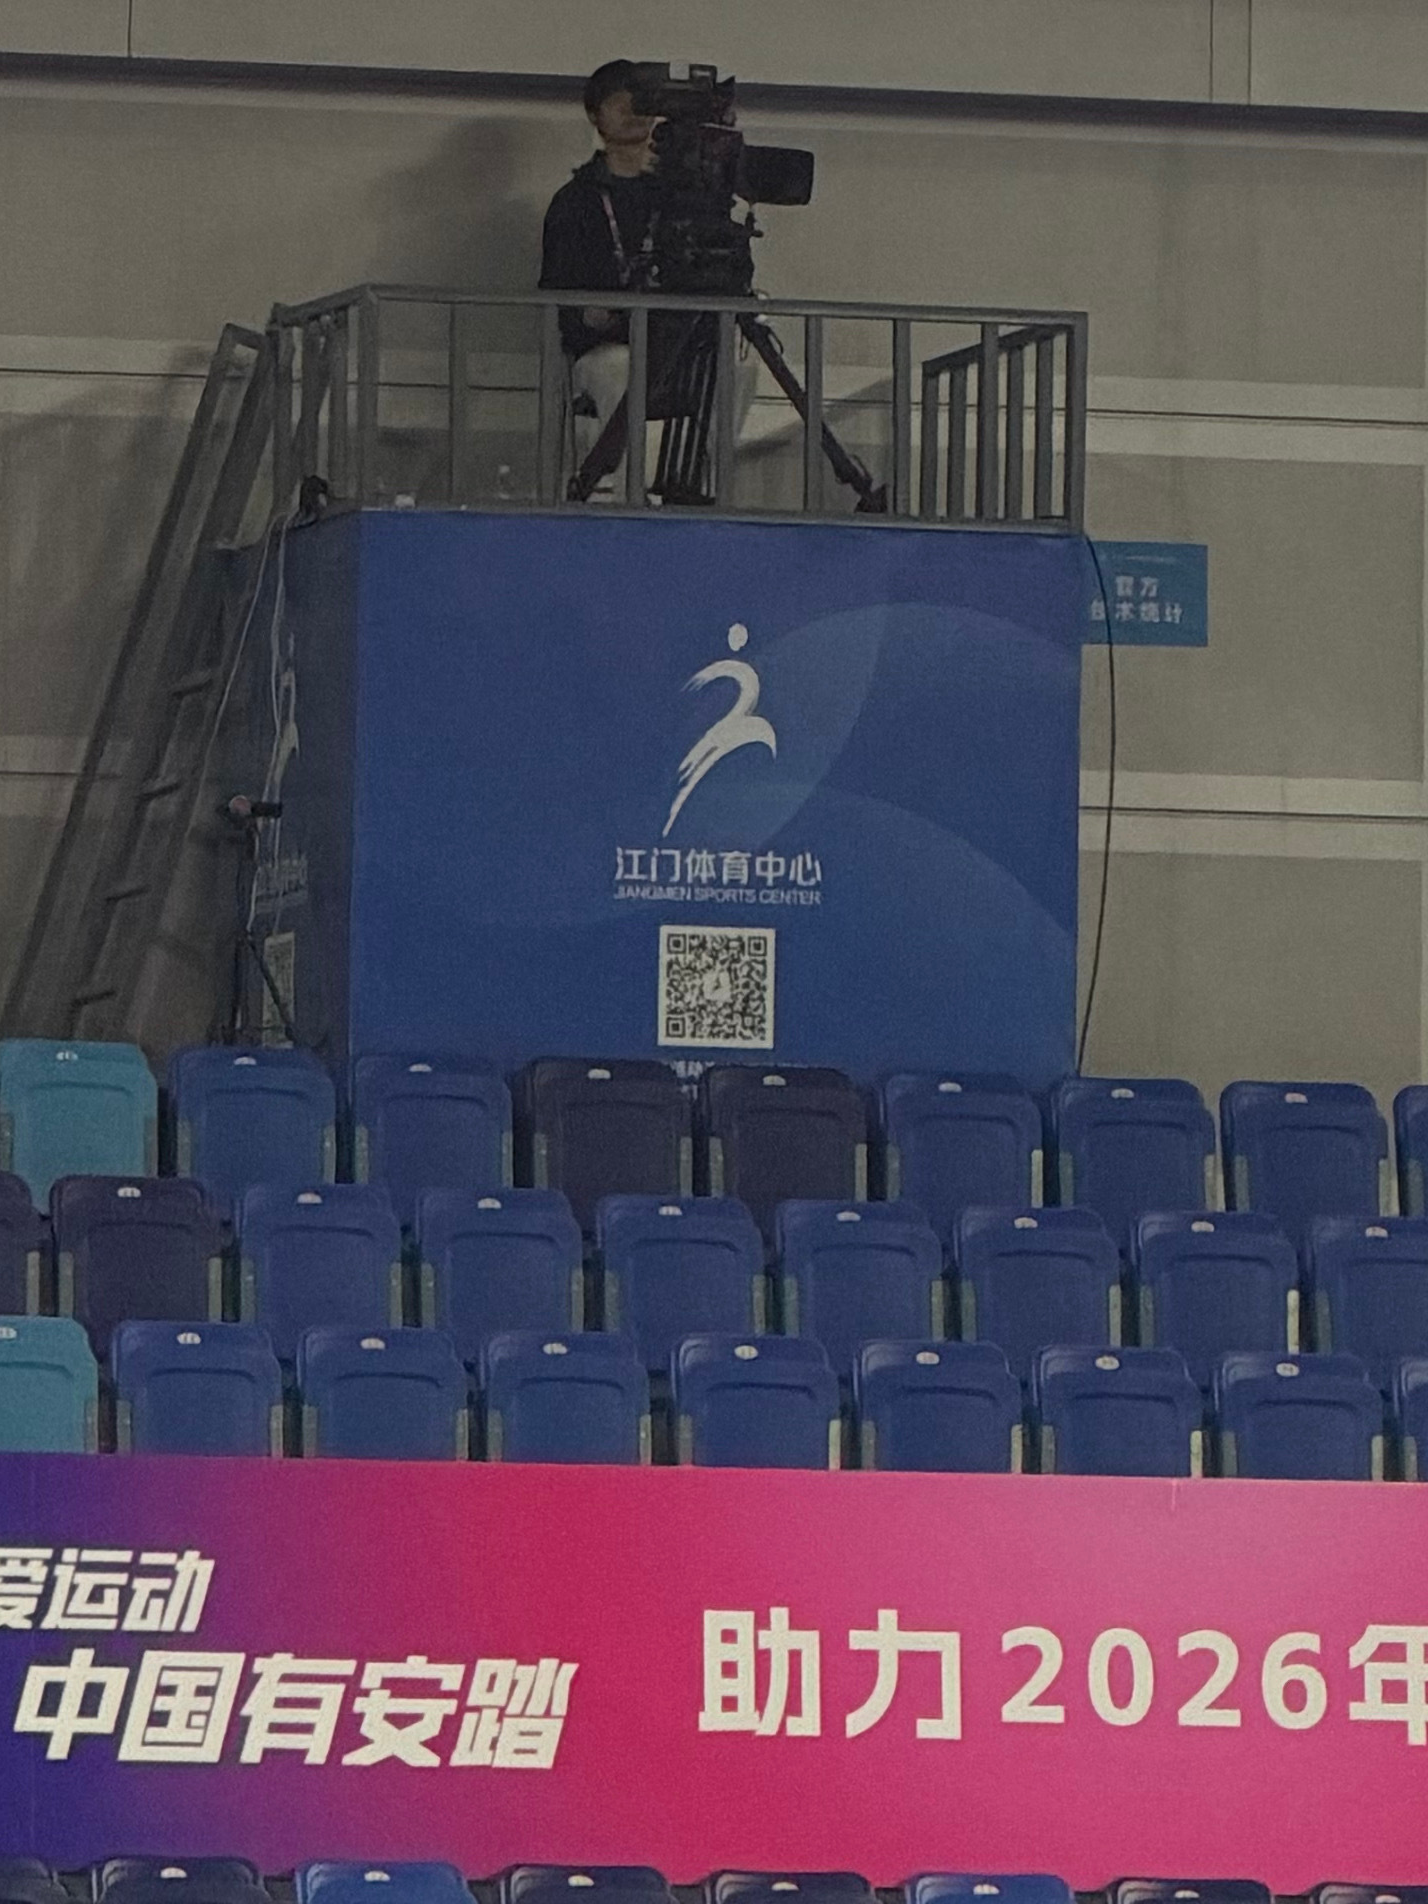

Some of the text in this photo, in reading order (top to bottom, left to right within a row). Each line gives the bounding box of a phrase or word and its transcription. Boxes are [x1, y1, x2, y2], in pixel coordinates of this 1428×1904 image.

[615, 847, 822, 886] 江门体育中心
[694, 887, 757, 904] SPORTS
[12, 1648, 580, 1770] 中国有安踏
